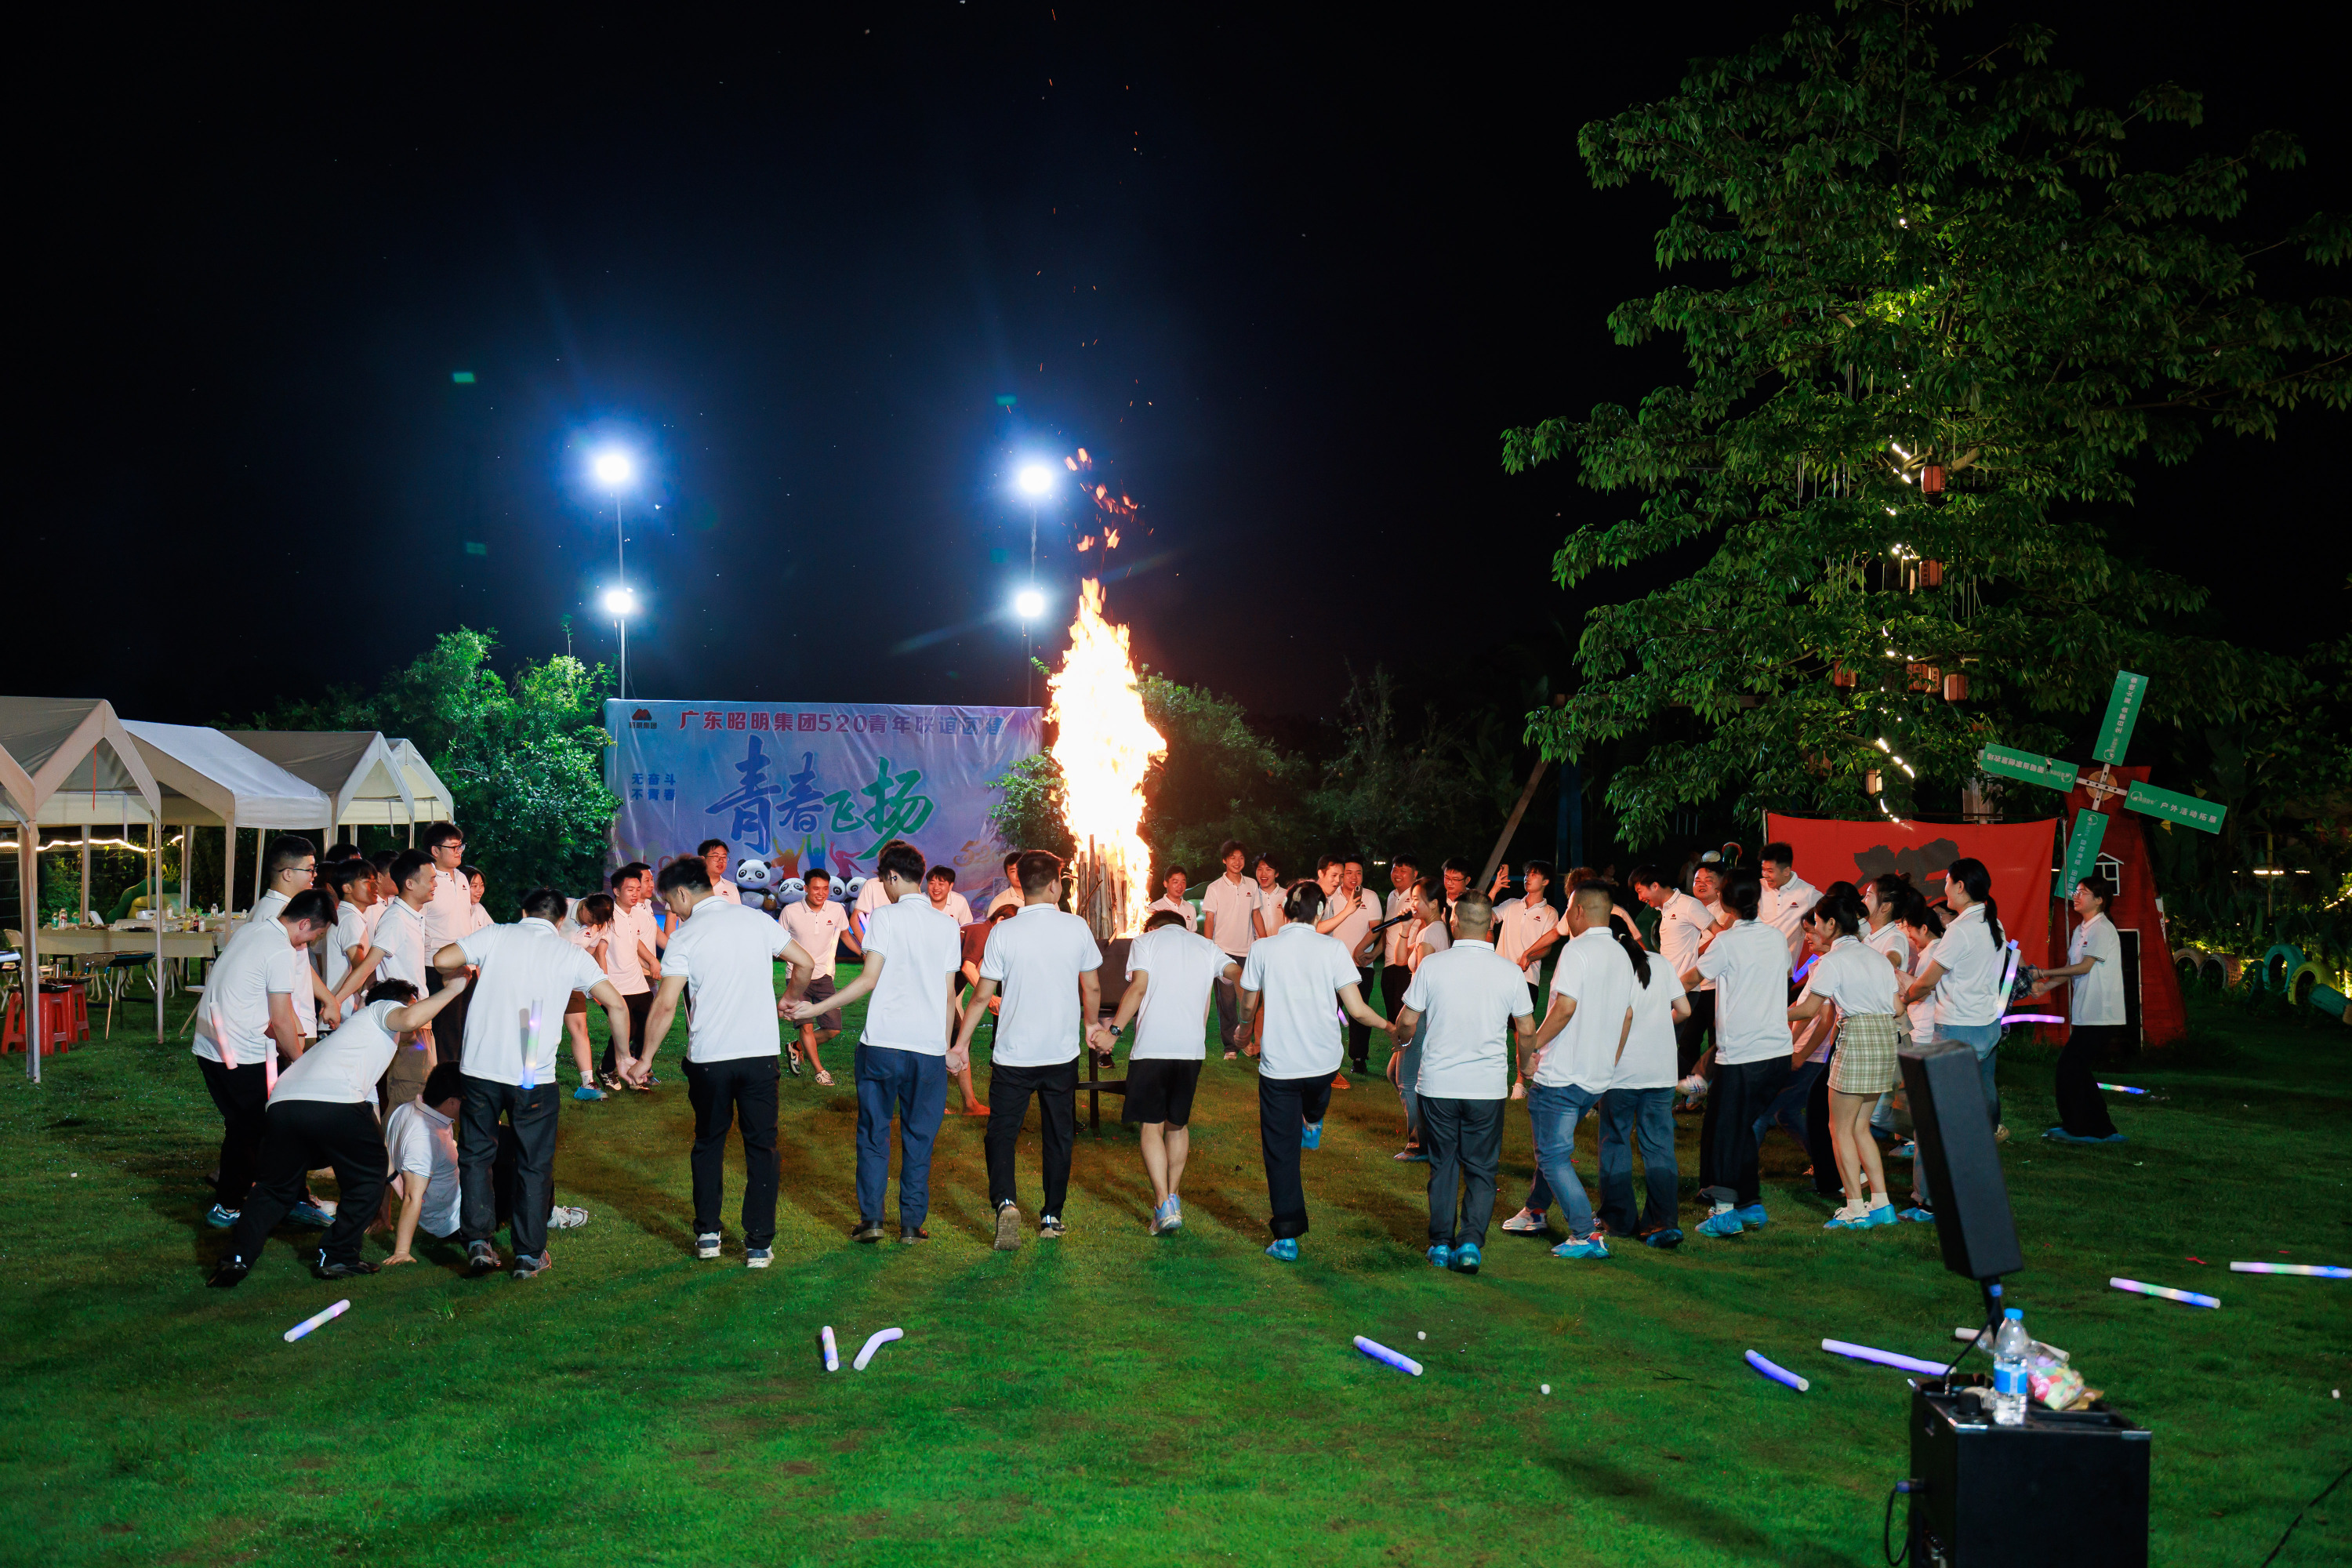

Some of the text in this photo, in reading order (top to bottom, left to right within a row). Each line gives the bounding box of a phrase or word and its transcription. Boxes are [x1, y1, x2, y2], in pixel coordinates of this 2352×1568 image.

[631, 773, 676, 785] 无奋斗
[631, 789, 675, 800] 不青春
[705, 734, 934, 860] 青春飞扬
[2160, 801, 2218, 825] 户外活动拓展
